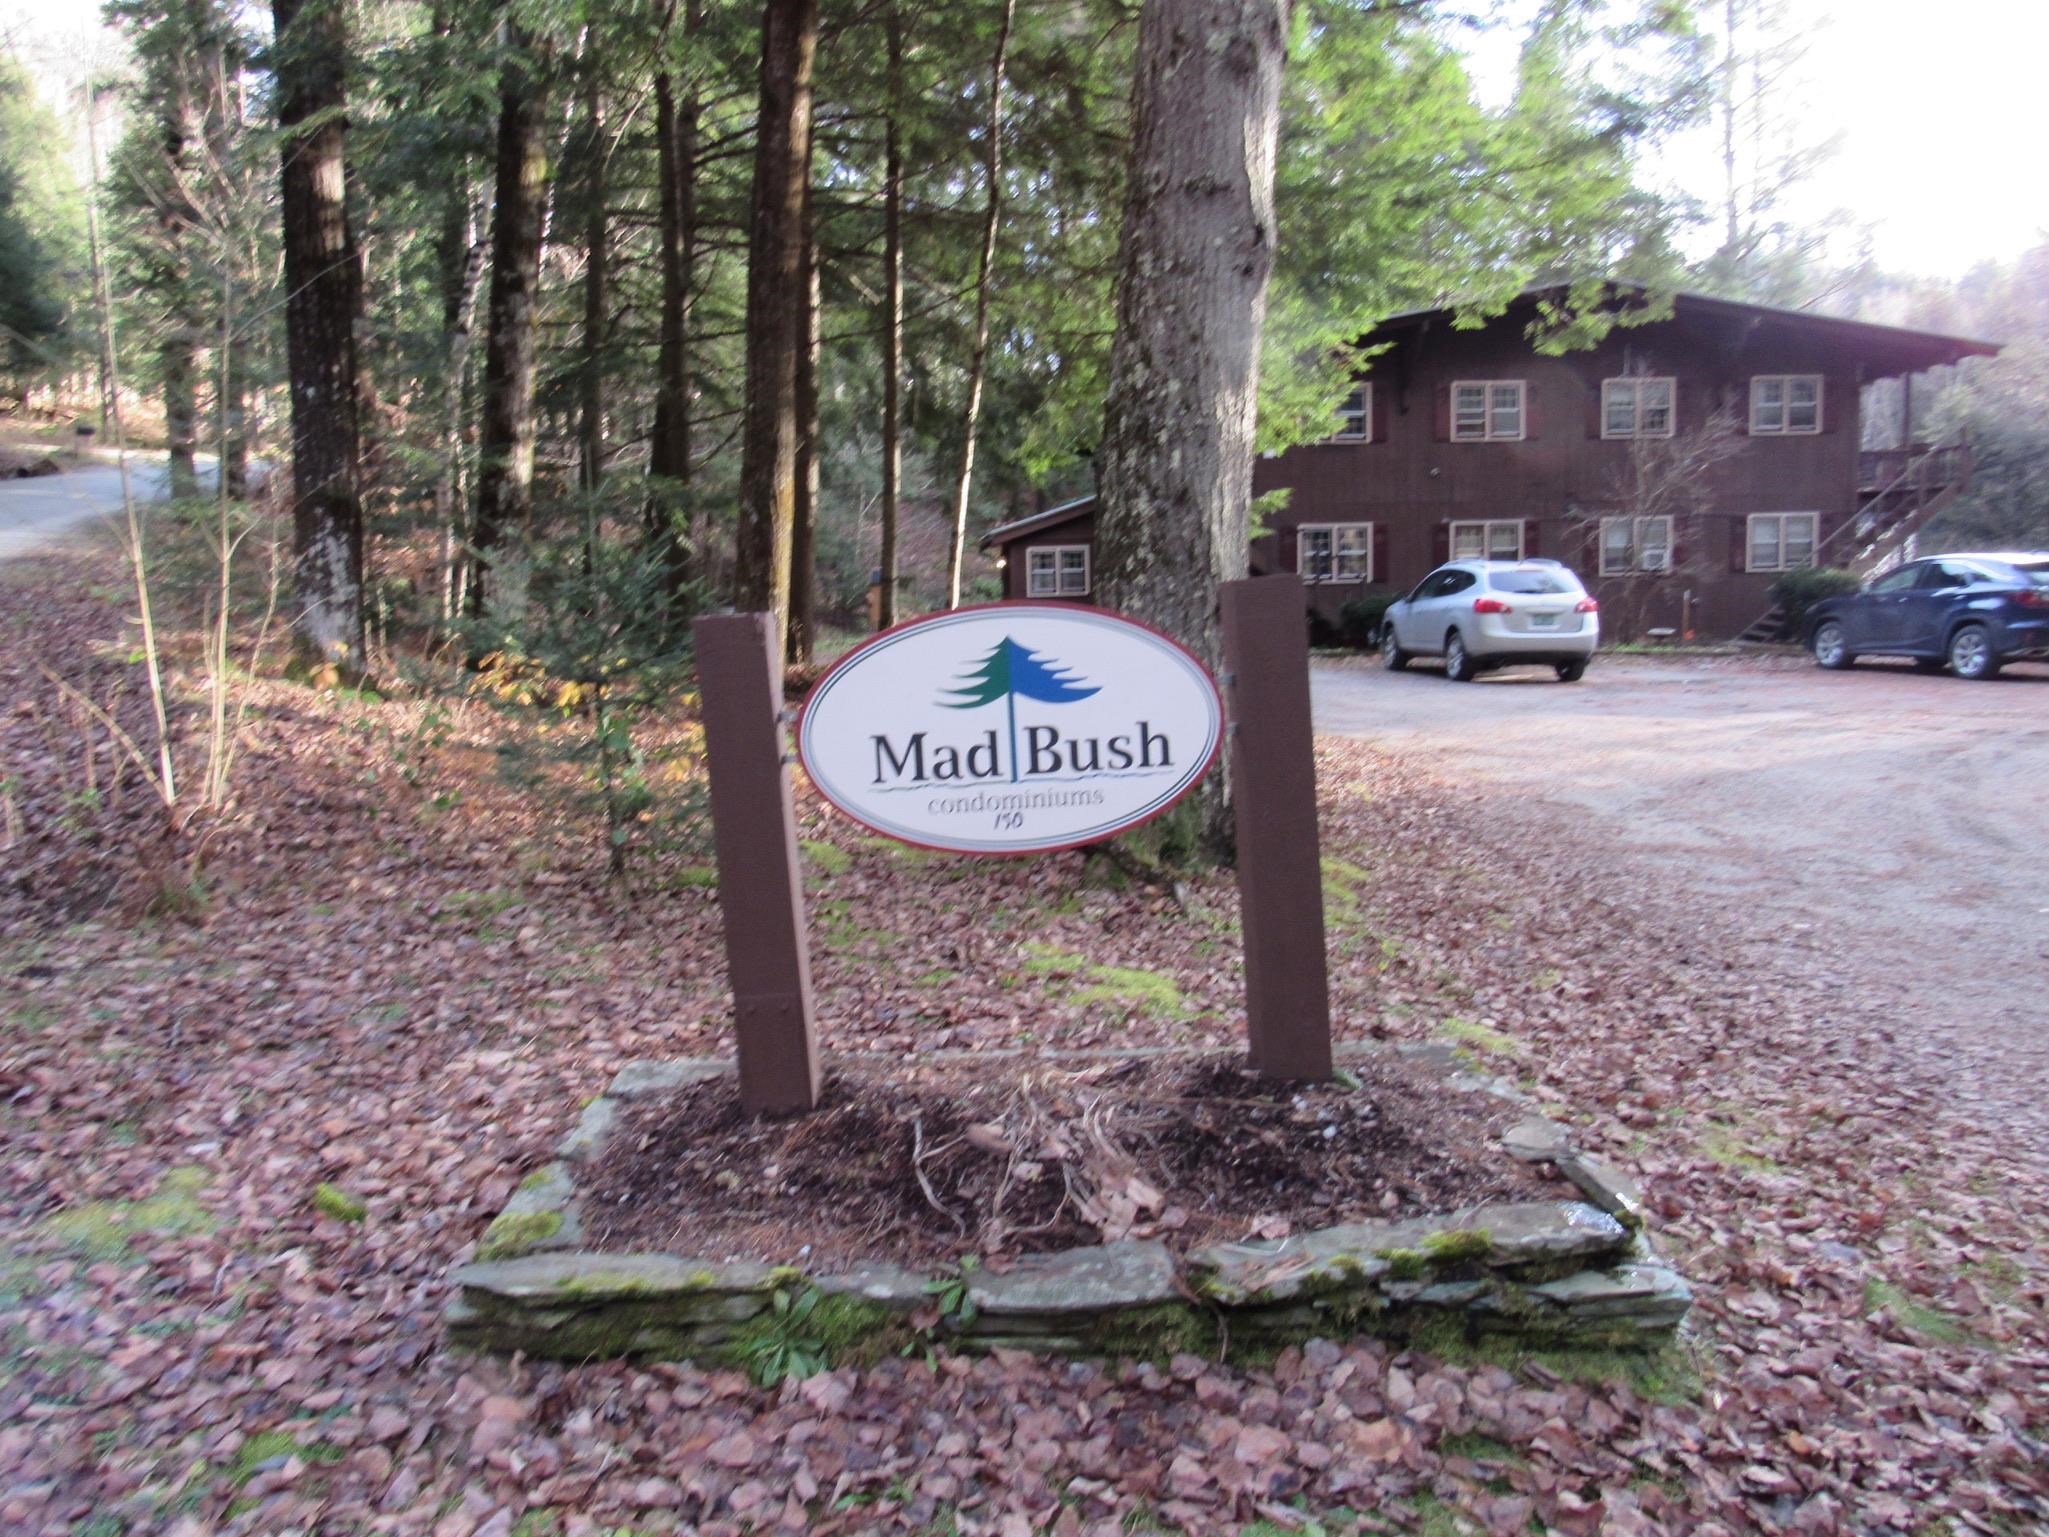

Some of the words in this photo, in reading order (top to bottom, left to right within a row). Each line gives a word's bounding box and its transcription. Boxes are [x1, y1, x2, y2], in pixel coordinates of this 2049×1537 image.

[871, 730, 1002, 783] Mad
[1023, 721, 1175, 774] Bush
[928, 788, 1104, 816] condominiums
